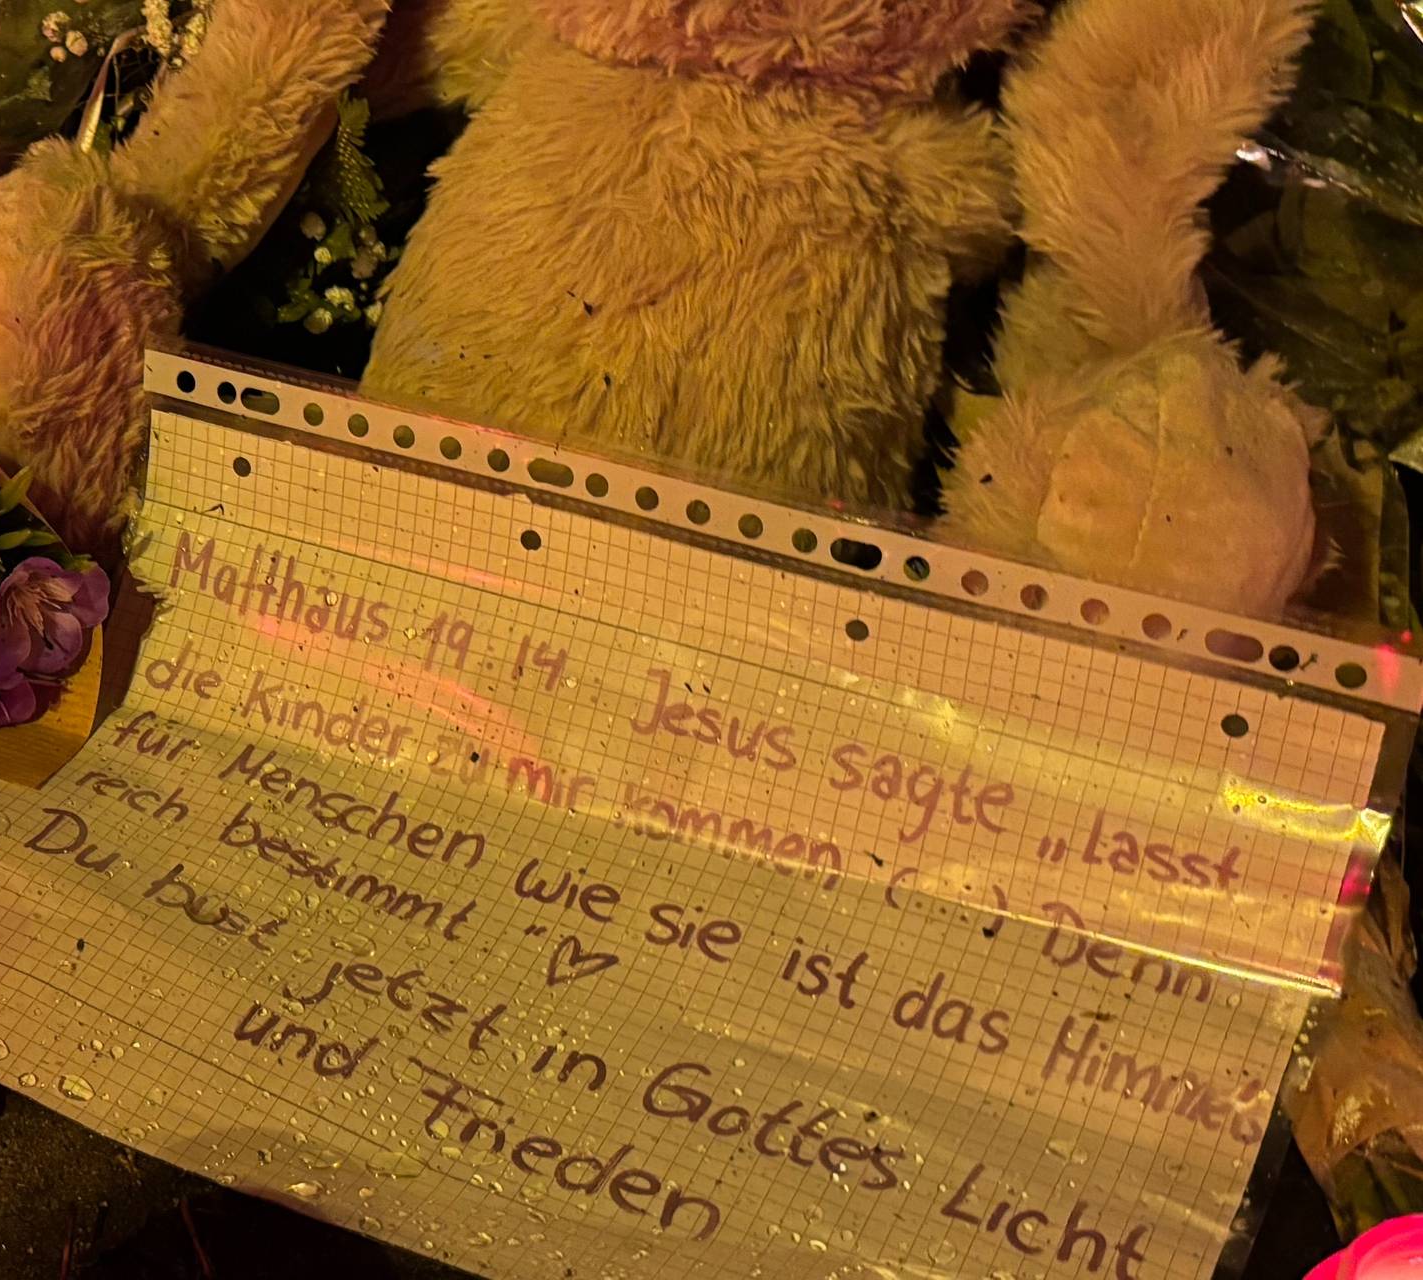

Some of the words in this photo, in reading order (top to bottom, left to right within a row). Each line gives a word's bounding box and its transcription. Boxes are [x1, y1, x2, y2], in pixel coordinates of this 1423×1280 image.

[76, 769, 190, 823] reich
[218, 802, 477, 942] bestimmt
[145, 640, 224, 700] die
[241, 672, 413, 758] Kinder
[429, 735, 489, 785] zu
[507, 755, 595, 806] mir
[614, 780, 842, 891] kommen
[1041, 901, 1214, 1003] Denn
[630, 669, 796, 772] Jesus
[829, 742, 1014, 843] sagte
[218, 743, 486, 869] Menschen
[514, 857, 621, 922] wie
[644, 902, 742, 963] sie
[782, 936, 869, 1009] ist
[893, 972, 1011, 1055] das
[24, 806, 121, 873] Du
[282, 961, 508, 1051] jetzt
[532, 1044, 608, 1092] in
[642, 1061, 907, 1190] Gottes
[940, 1163, 1153, 1280] Licht
[233, 1000, 381, 1079] und
[408, 1055, 721, 1241] Frieden
